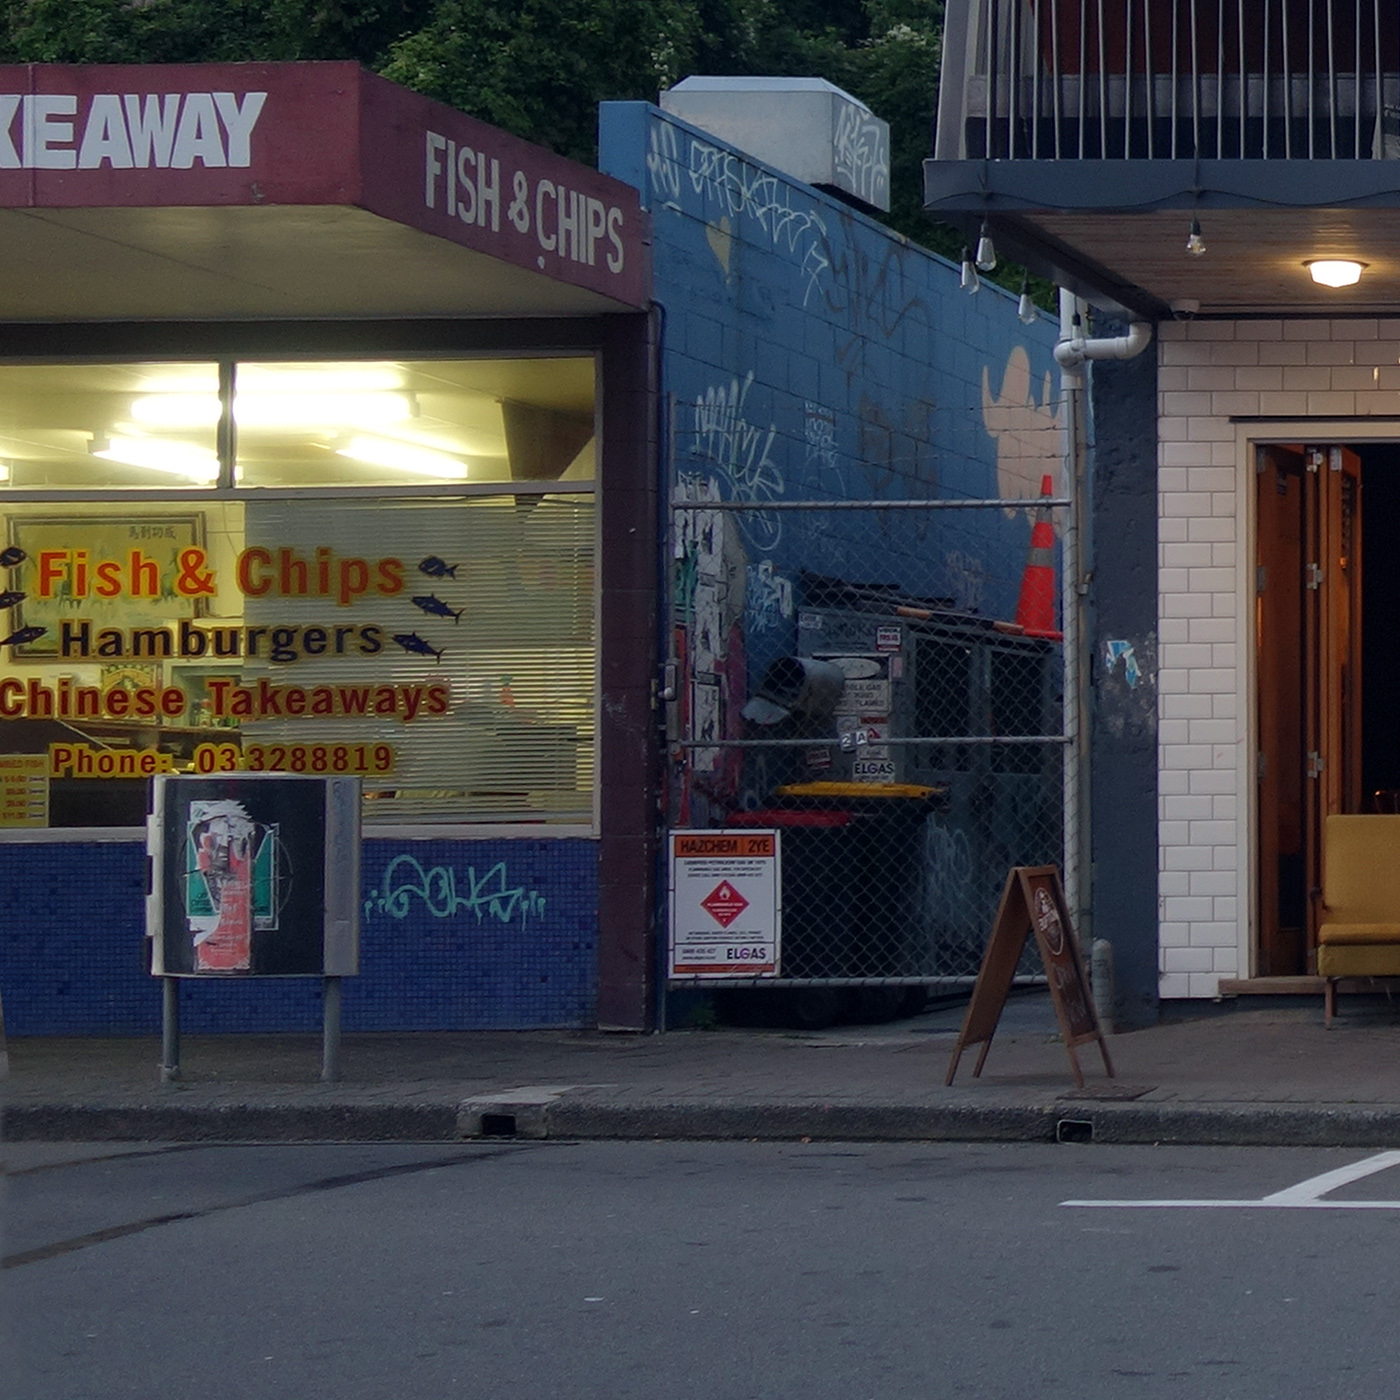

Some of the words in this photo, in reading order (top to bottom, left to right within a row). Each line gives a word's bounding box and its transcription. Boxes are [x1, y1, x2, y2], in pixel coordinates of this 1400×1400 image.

[425, 130, 500, 233] FISH
[507, 170, 530, 234] &
[535, 179, 624, 275] CHIPS
[38, 550, 159, 597] Fish
[177, 548, 216, 597] &
[238, 546, 405, 607] Chips
[60, 619, 383, 663] Hamburgers
[0, 677, 186, 716] Chinese
[207, 679, 451, 721] Takeaways
[52, 747, 170, 775] Phone:
[198, 747, 238, 773] 03
[247, 746, 393, 773] 3288819
[854, 762, 894, 775] ELGAS
[680, 839, 738, 853] HAZCHEM
[747, 839, 770, 853] 2YE
[726, 947, 767, 960] ELGAS
